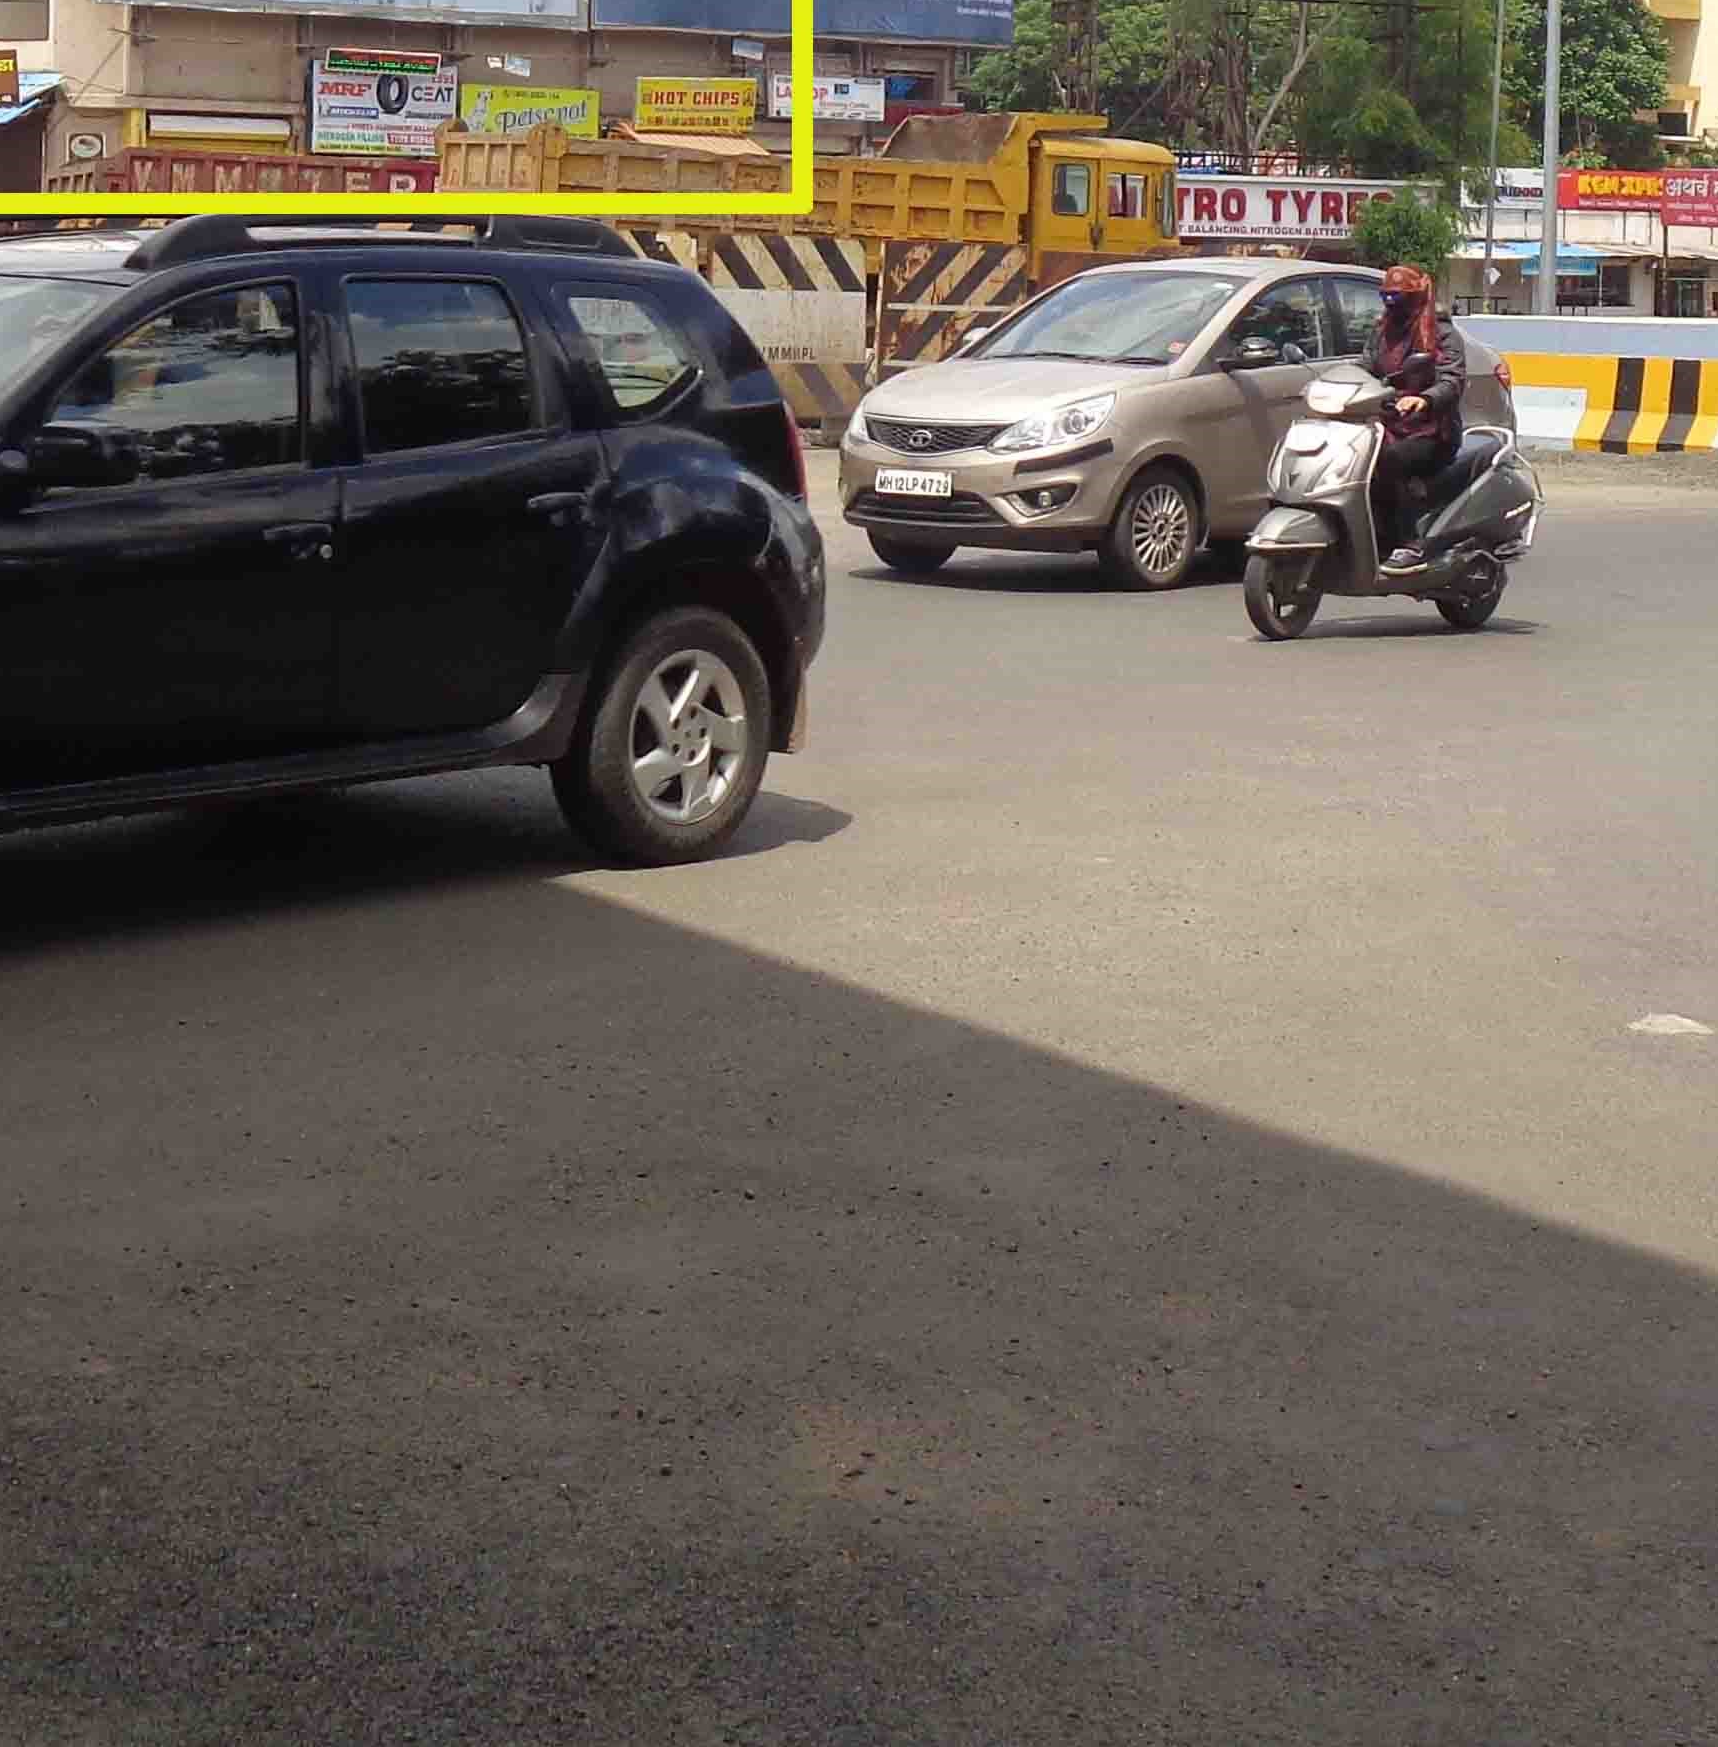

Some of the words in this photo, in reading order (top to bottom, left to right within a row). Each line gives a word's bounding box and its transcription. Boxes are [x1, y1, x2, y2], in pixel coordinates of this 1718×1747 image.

[318, 82, 372, 97] MRF
[411, 86, 454, 102] CEAT
[693, 92, 740, 106] CHIPS
